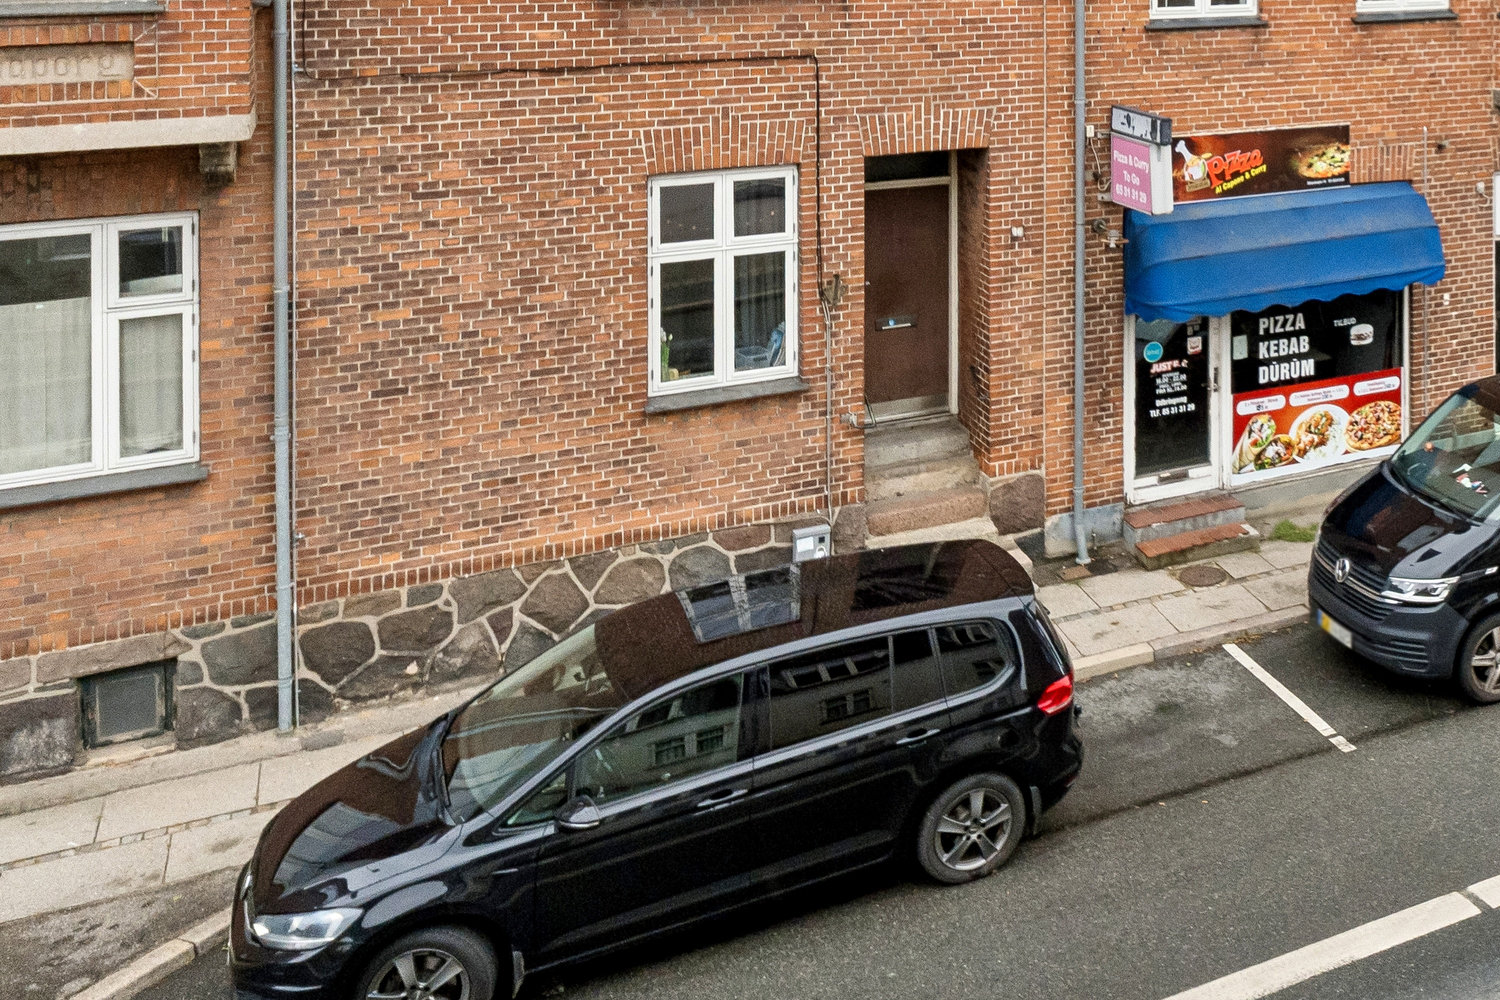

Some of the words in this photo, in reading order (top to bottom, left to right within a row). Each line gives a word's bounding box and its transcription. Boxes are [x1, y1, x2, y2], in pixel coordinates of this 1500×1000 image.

[1113, 150, 1128, 163] Pizza
[1133, 156, 1149, 173] Curry
[1250, 164, 1267, 176] Curry
[1122, 170, 1131, 183] To
[1131, 173, 1140, 186] Go
[1258, 312, 1306, 335] PIZZA
[1333, 317, 1357, 327] TILBUD
[1258, 335, 1310, 359] KEBAB
